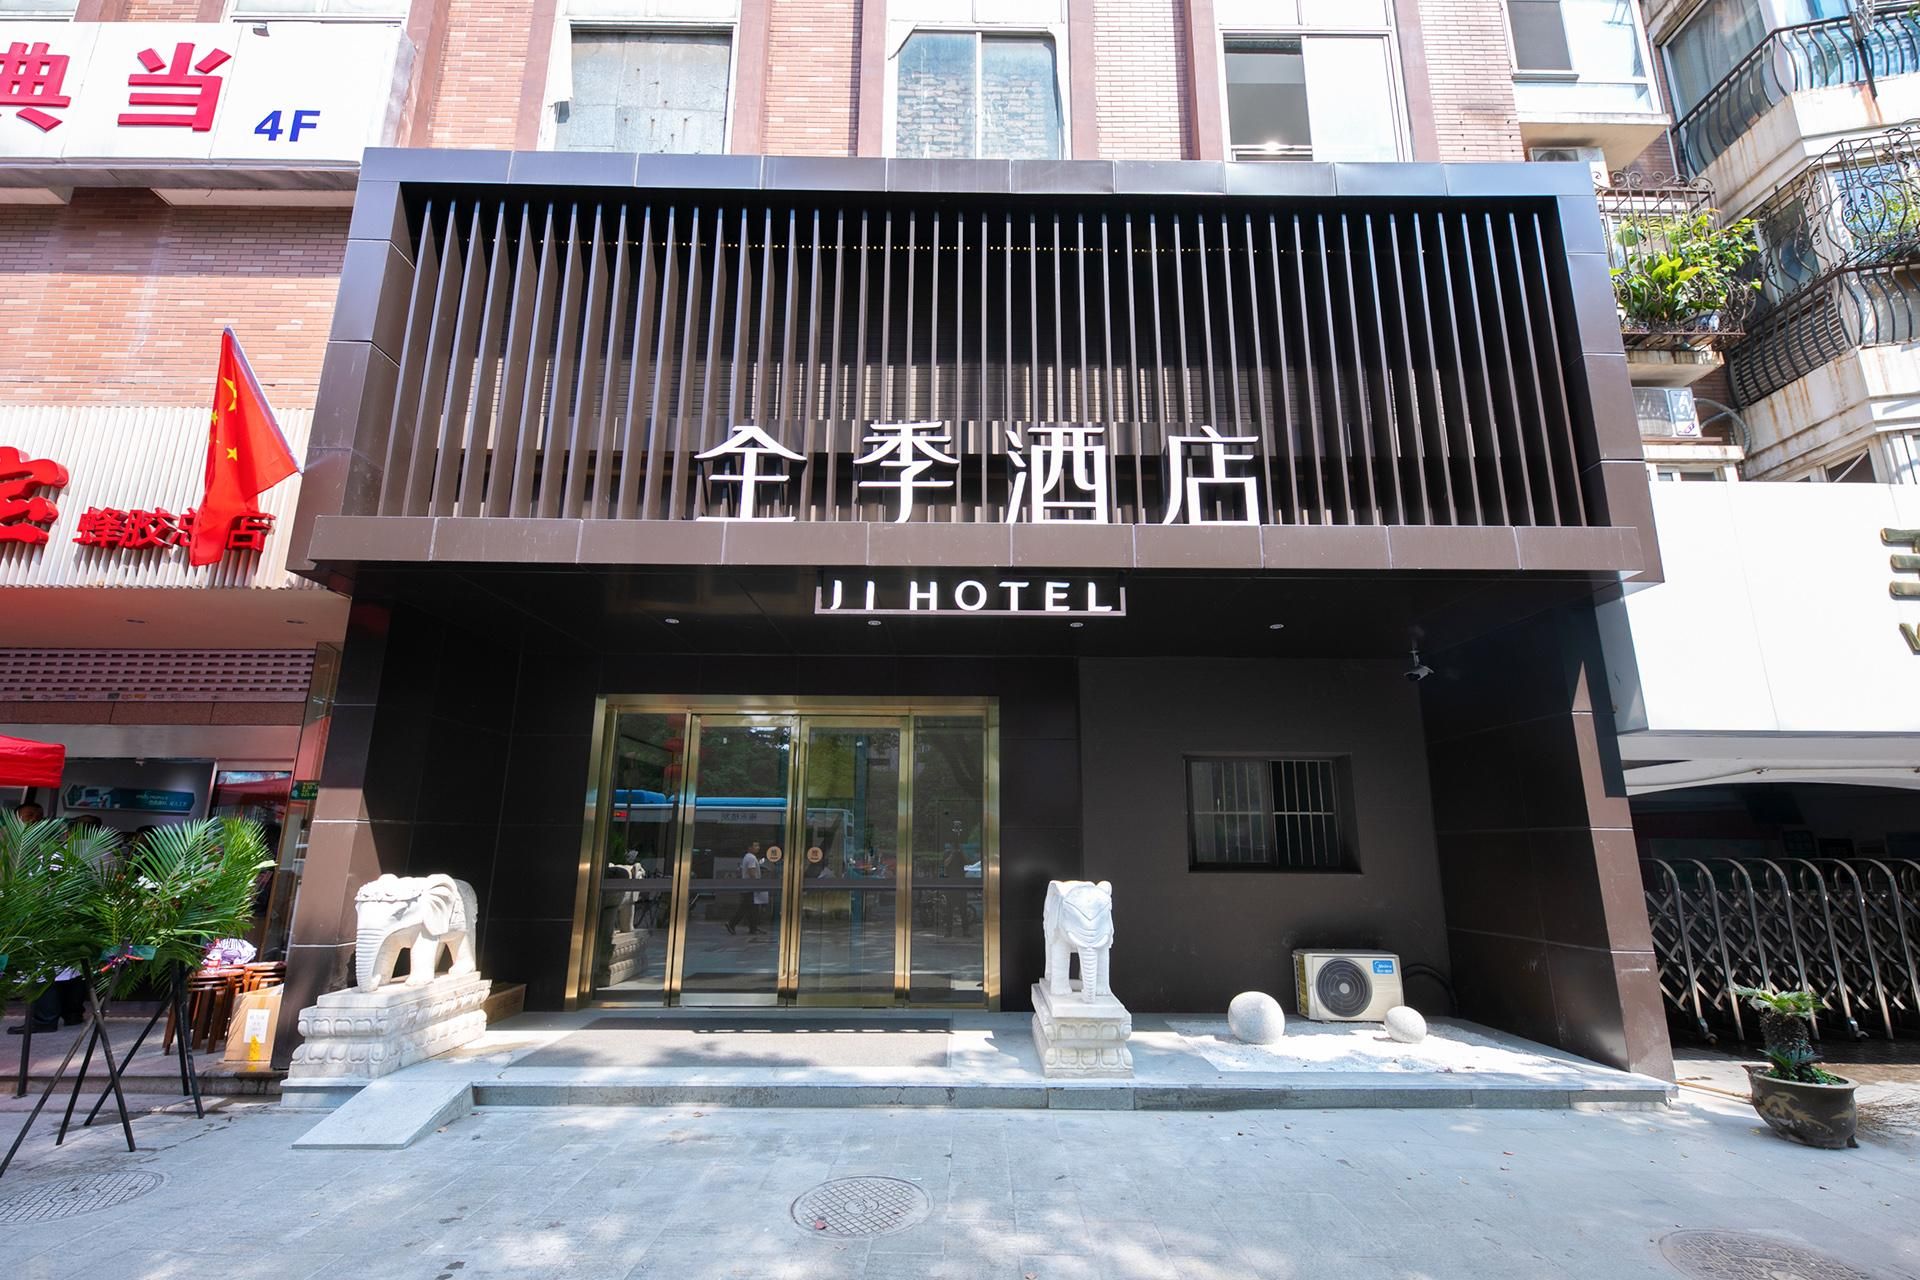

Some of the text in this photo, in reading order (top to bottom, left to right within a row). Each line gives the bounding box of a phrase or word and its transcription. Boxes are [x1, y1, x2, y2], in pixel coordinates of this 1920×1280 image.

[254, 109, 321, 142] 4F
[693, 420, 1260, 526] 全季酒店
[829, 579, 1113, 612] JI HOTEL
